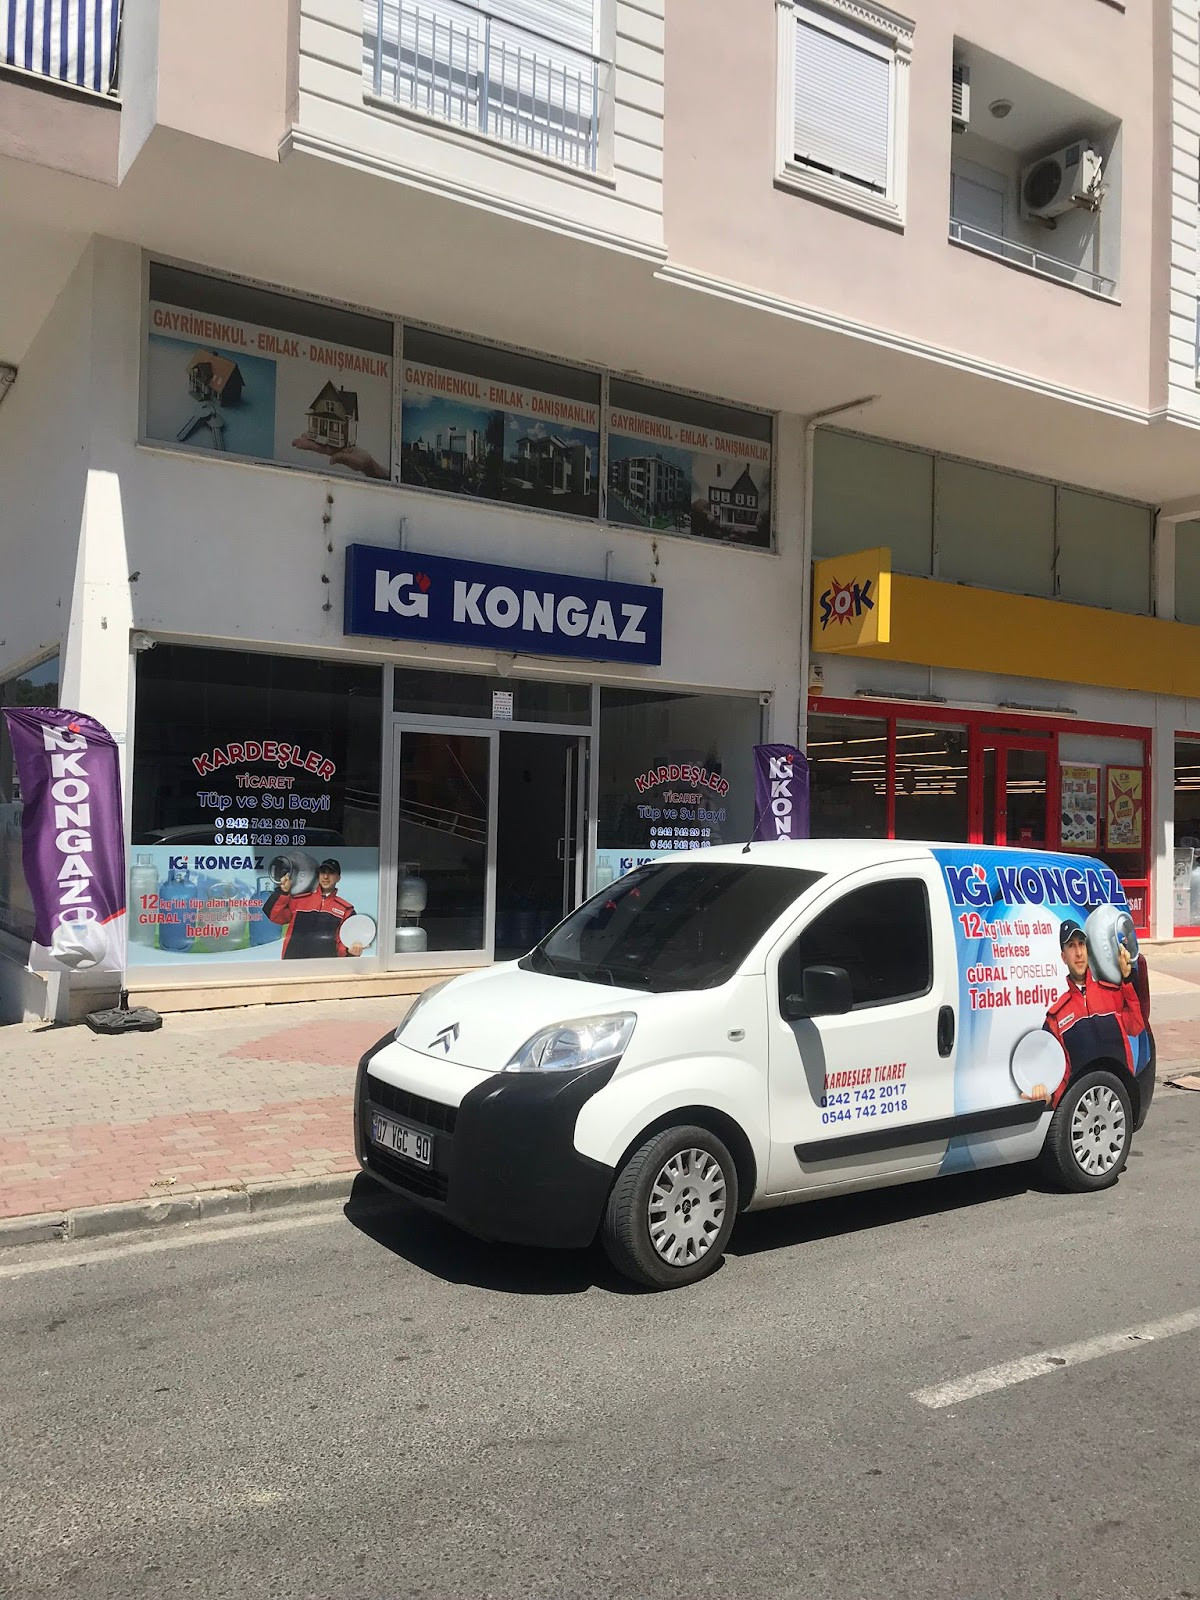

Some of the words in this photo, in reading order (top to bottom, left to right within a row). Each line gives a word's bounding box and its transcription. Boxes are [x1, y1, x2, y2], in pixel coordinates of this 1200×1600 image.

[153, 308, 247, 346] GAYRİMENKUL
[257, 332, 300, 358] EMLAK
[309, 343, 388, 378] DANIŞMANLIK
[405, 366, 481, 399] GAYRİMENKUL
[489, 390, 523, 409] EMLAK
[531, 398, 596, 426] DANIŞMANLIK
[610, 413, 673, 441] GAYRİMENKUL
[680, 431, 708, 448] EMLAK
[715, 437, 769, 463] DANIŞMANLIK
[453, 580, 648, 644] KONGAZ
[820, 579, 874, 631] ŞOK
[192, 740, 336, 781] KARDEŞLER
[236, 772, 295, 789] TİCARET
[635, 765, 729, 797] KARDEŞLER
[197, 791, 232, 811] Tüp
[236, 796, 258, 808] ve
[261, 793, 284, 809] Su
[288, 794, 331, 813] Bayii
[663, 790, 702, 804] TİCARET
[214, 817, 224, 828] 0
[226, 818, 249, 828] 242
[251, 818, 273, 829] 742
[275, 818, 290, 829] 20
[292, 818, 306, 829] 17
[637, 805, 661, 821] Tüp
[663, 808, 678, 819] ve
[680, 807, 695, 820] Su
[697, 808, 726, 823] Bayii
[51, 752, 93, 905] KONGAZ
[214, 833, 224, 844] 0
[225, 833, 248, 844] 544
[250, 833, 272, 845] 742
[274, 834, 290, 845] 20
[292, 834, 306, 845] 18
[650, 826, 656, 836] 0
[657, 827, 672, 836] 242
[674, 827, 688, 836] 742
[689, 827, 700, 836] 20
[650, 839, 656, 849] 0
[674, 840, 688, 849] 742
[194, 856, 264, 870] KONGAZ
[995, 866, 1127, 906] KONGAZ
[139, 894, 159, 909] 12
[189, 898, 204, 909] tüp
[206, 898, 225, 909] alan
[228, 897, 263, 908] herkese
[1126, 897, 1142, 911] SAT
[139, 912, 180, 924] GÜRAL
[959, 912, 983, 939] 12
[983, 921, 1012, 939] kg'lık
[1014, 921, 1030, 937] tüp
[1033, 920, 1053, 936] alan
[186, 924, 229, 938] hediye
[992, 943, 1030, 958] Herkese
[967, 965, 1008, 984] GÜRAL
[1010, 964, 1058, 979] PORSELEN
[969, 990, 1012, 1010] Tabak
[1015, 986, 1058, 1007] hediye
[823, 1068, 872, 1090] KARDEŞLER
[874, 1063, 907, 1083] TİCARET
[821, 1093, 850, 1108] 0242
[854, 1088, 876, 1102] 742
[879, 1084, 907, 1098] 2017
[822, 1109, 852, 1124] 0544
[855, 1104, 877, 1119] 742
[880, 1100, 908, 1114] 2018
[378, 1119, 387, 1142] 07
[416, 1136, 428, 1161] 90
